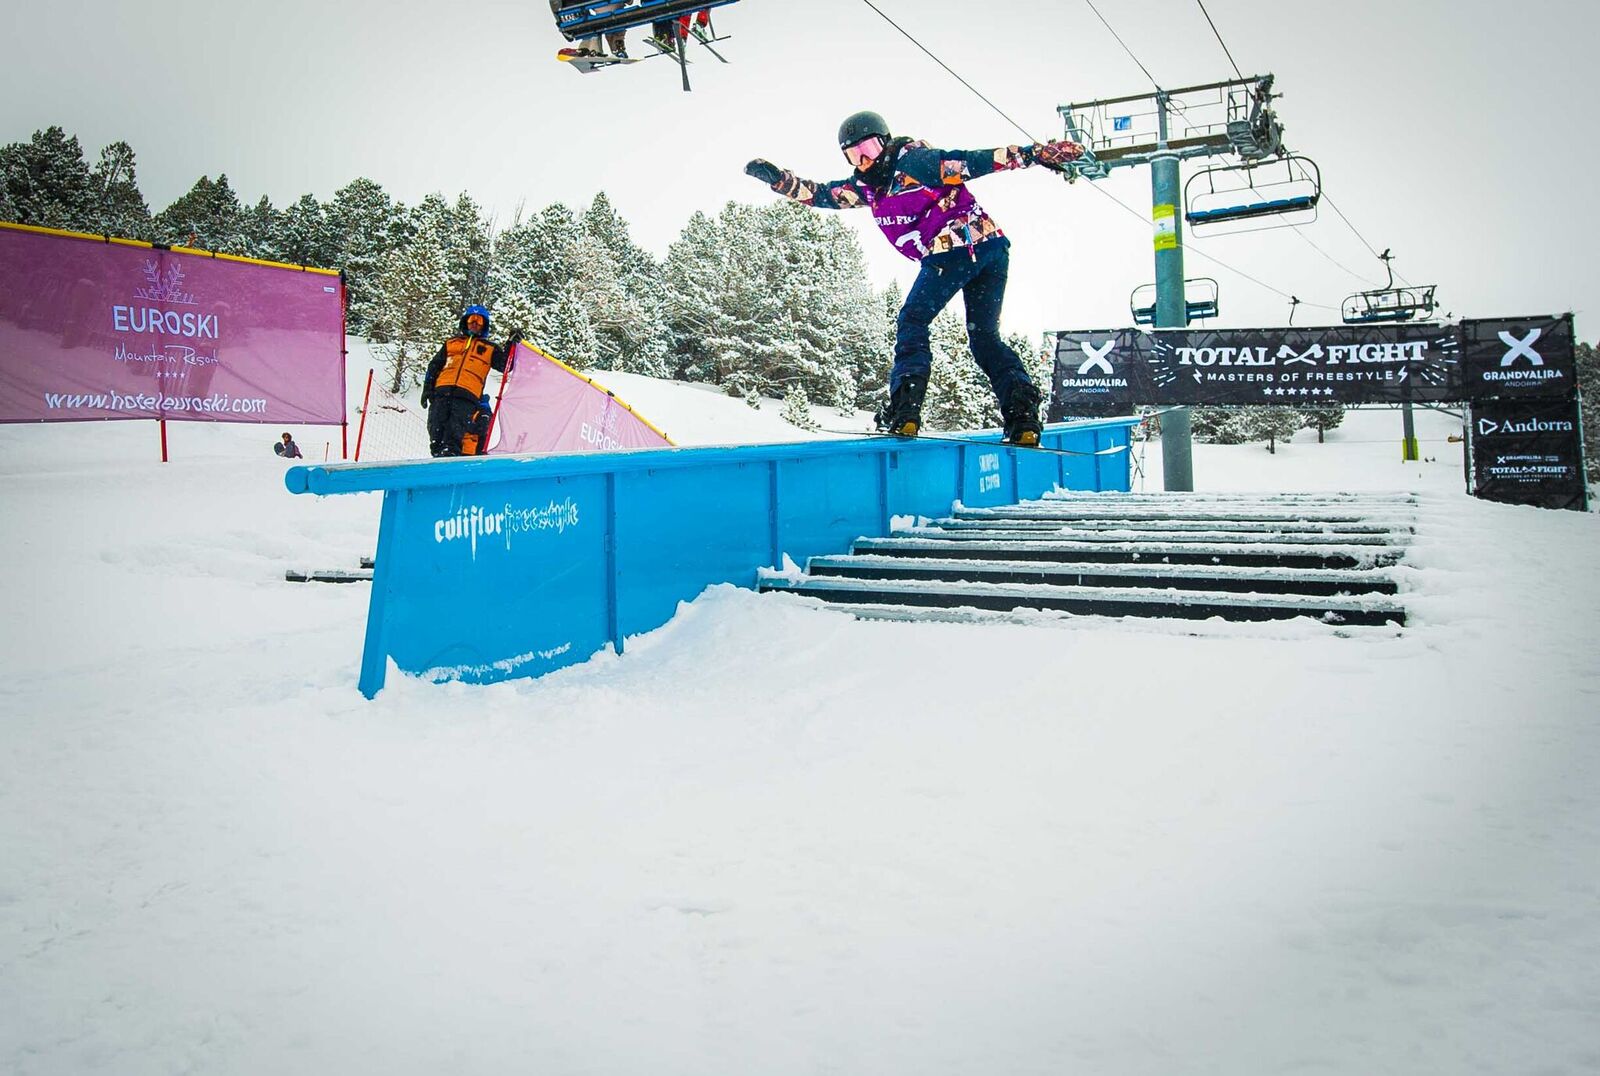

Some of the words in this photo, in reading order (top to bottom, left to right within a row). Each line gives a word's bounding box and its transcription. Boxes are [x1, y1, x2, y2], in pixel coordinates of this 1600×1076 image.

[112, 305, 219, 338] EUROSKI
[114, 342, 176, 363] Mountain
[1175, 347, 1276, 366] TOTAL
[1326, 341, 1428, 365] FIGHT
[1062, 378, 1128, 387] GRANDVALIRA
[1207, 373, 1274, 382] MASTERS
[1281, 373, 1299, 382] OF
[1306, 371, 1394, 380] FREESTYLE
[1482, 370, 1563, 381] GRANDVALIRA
[45, 389, 267, 414] www.hoteleuroski.com
[1500, 418, 1573, 433] Andorra
[580, 422, 623, 450] EUROS
[1490, 466, 1523, 474] TOTAL
